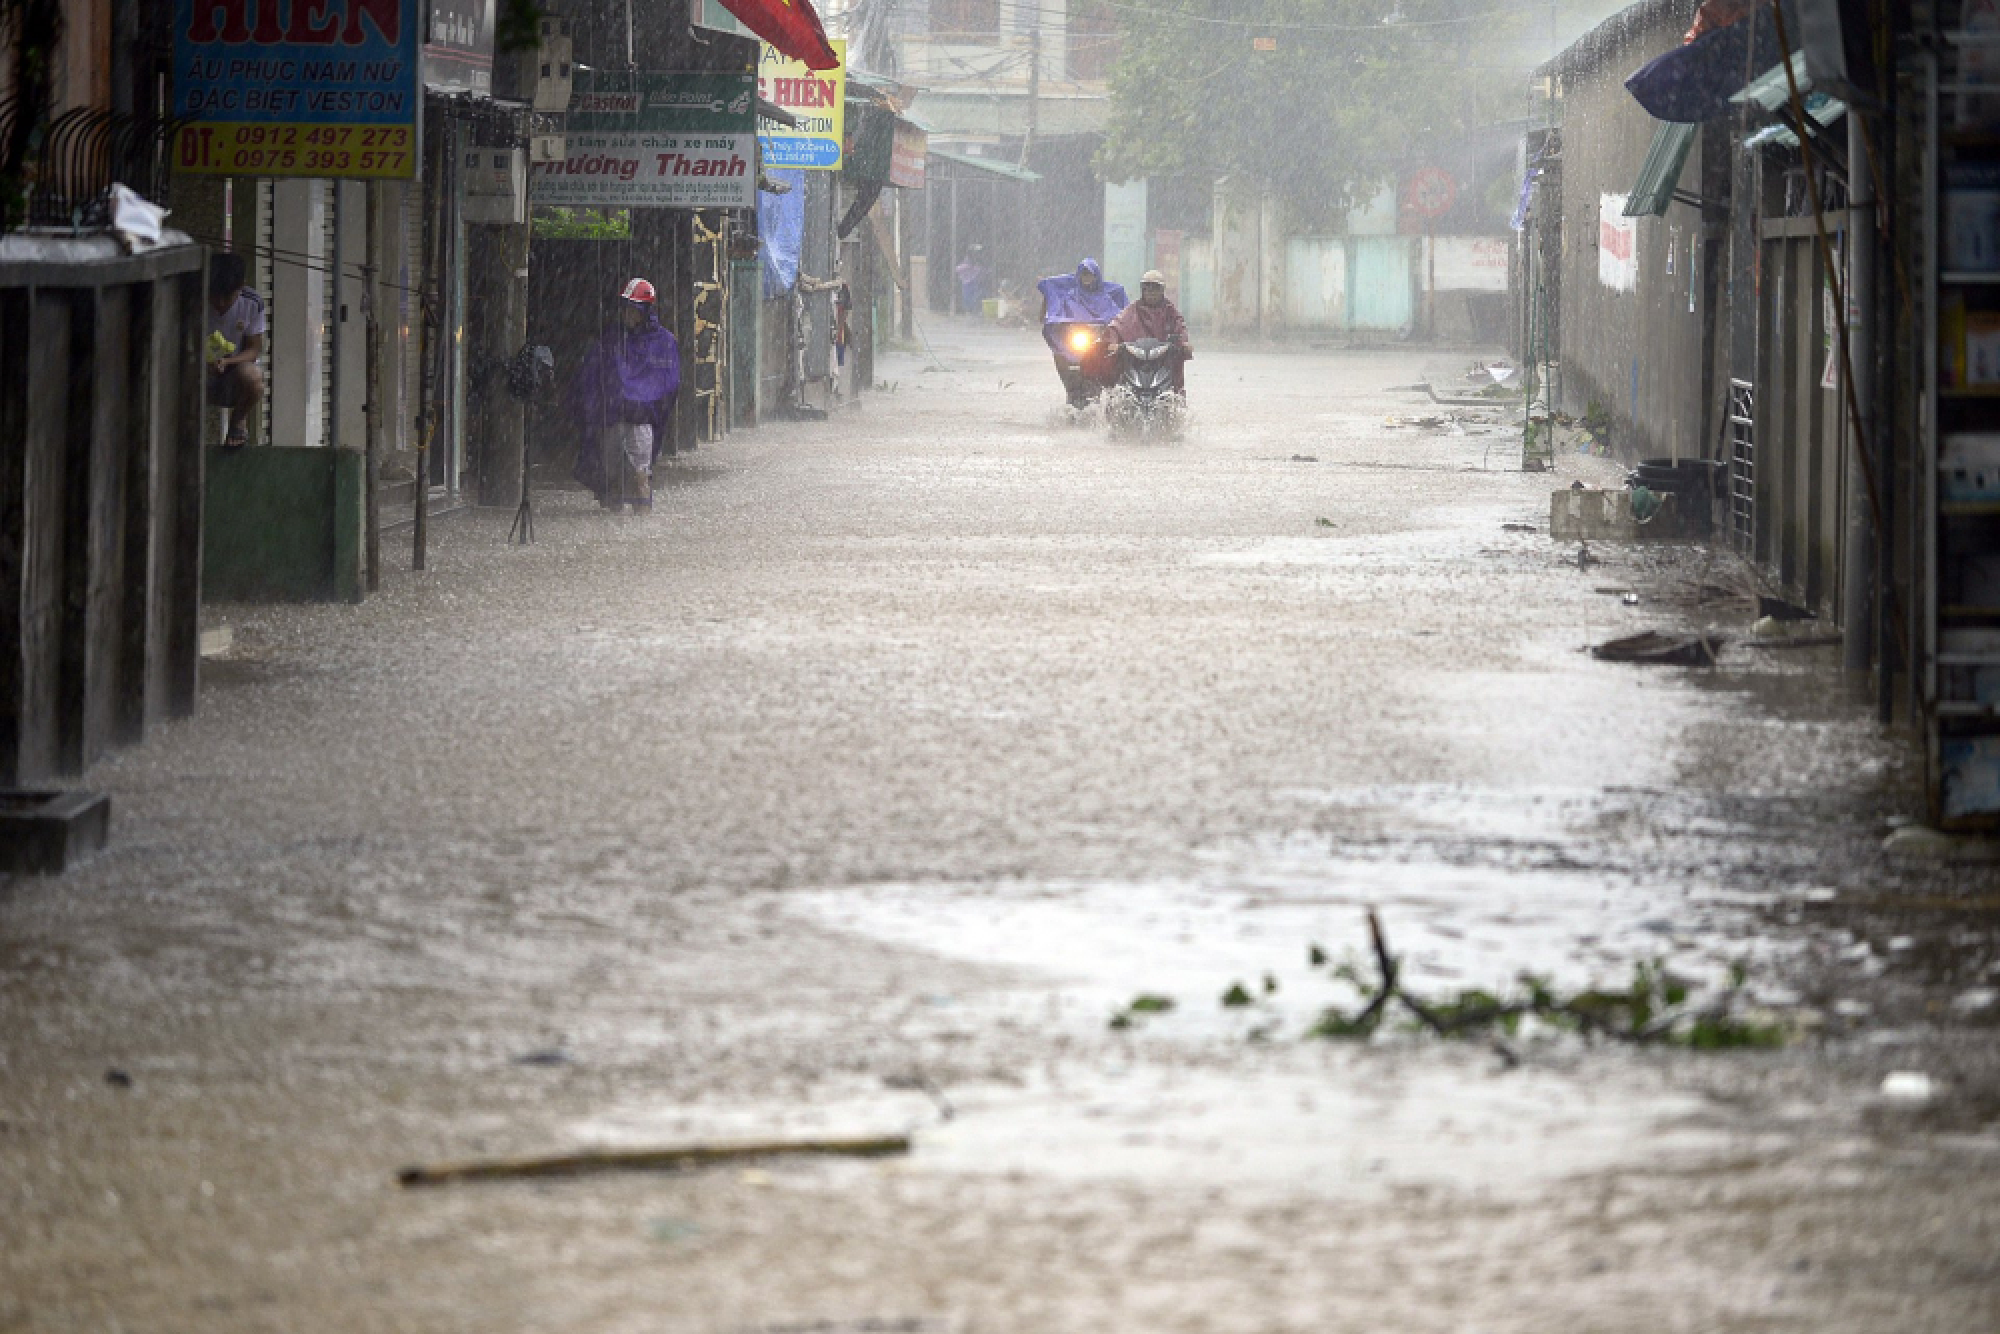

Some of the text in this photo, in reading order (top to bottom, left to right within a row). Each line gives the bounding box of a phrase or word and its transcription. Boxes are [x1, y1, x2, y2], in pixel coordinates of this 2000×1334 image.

[187, 55, 224, 82] ÂU
[229, 58, 296, 85] PHỤC
[301, 60, 357, 82] NAM
[245, 88, 300, 115] BIỆT
[306, 90, 404, 112] VESTON
[581, 93, 637, 111] Castrol
[233, 126, 297, 145] 0912
[304, 127, 353, 146] 497
[360, 127, 409, 147] 273
[683, 138, 702, 149] xe
[705, 135, 737, 151] máy
[233, 149, 408, 170] 0975 393 577
[655, 153, 748, 177] Thanh
